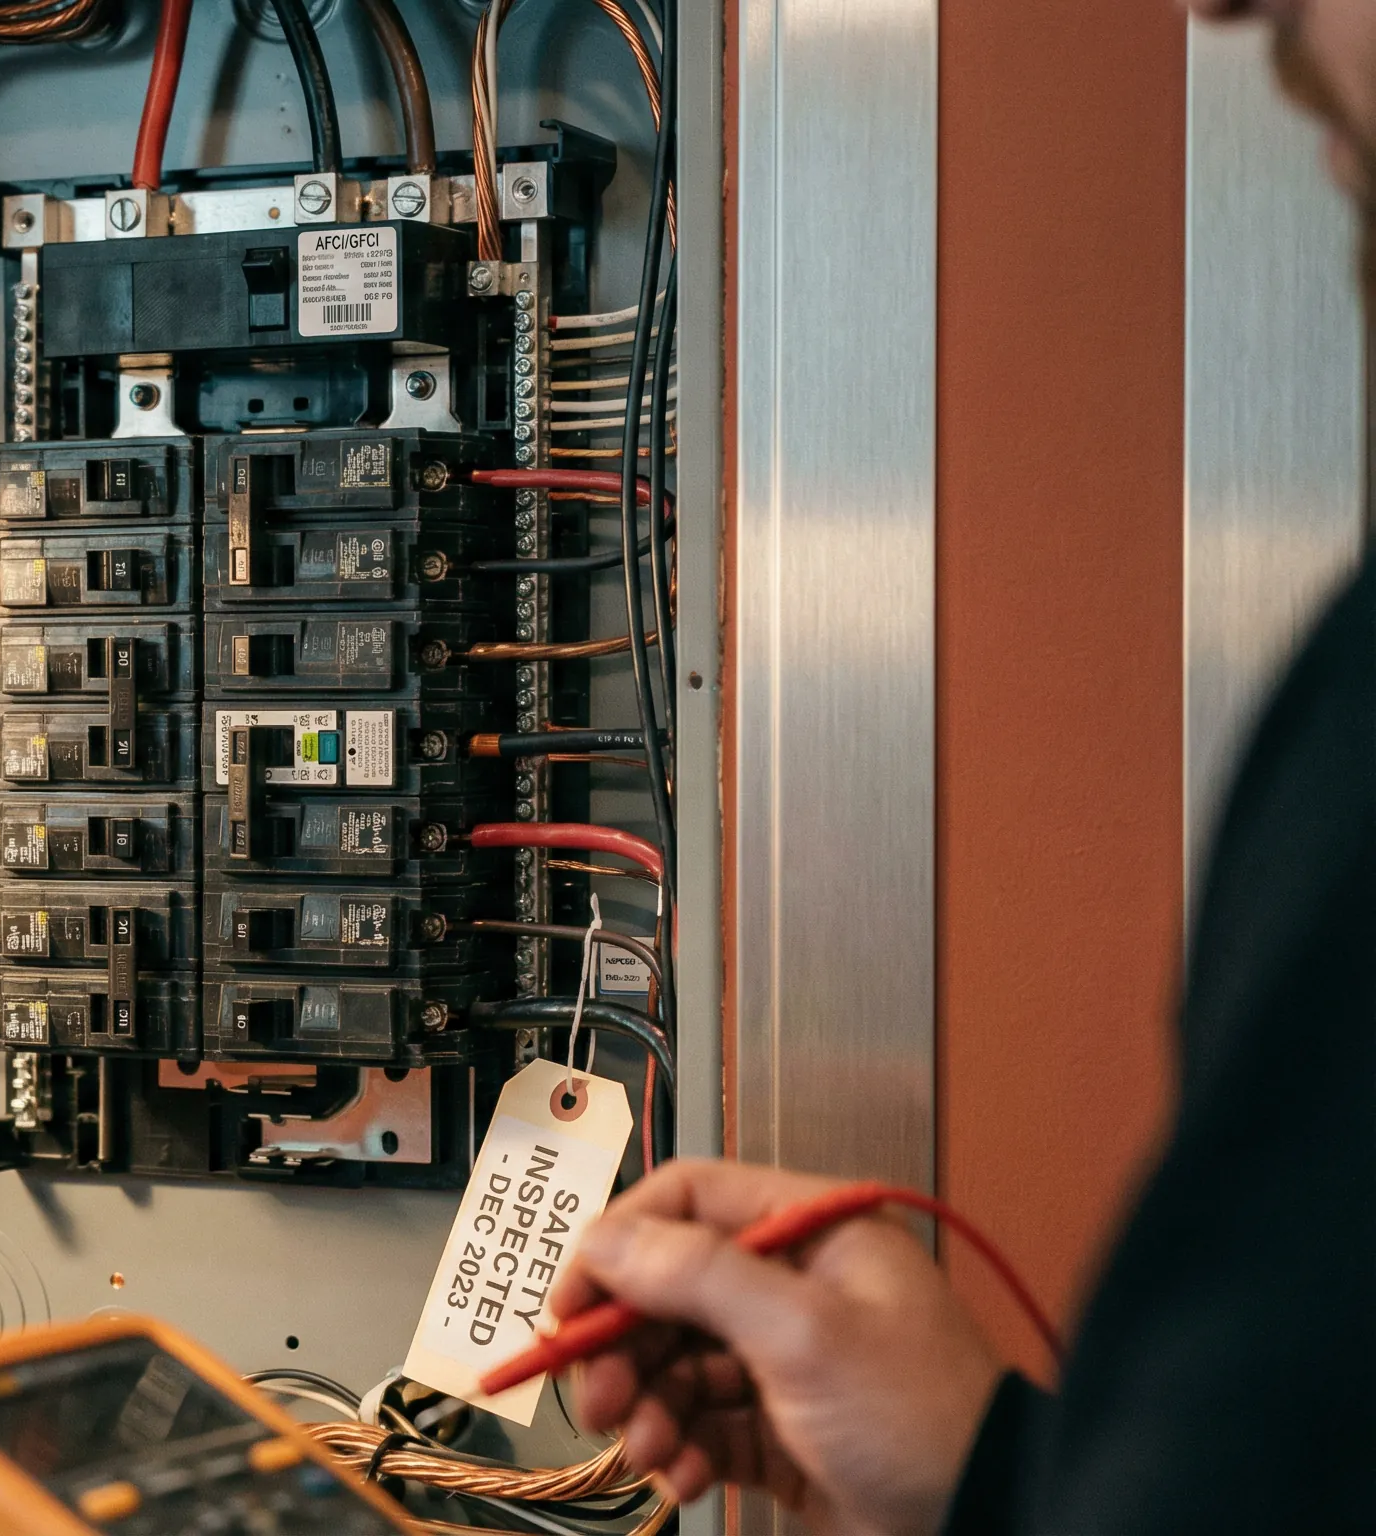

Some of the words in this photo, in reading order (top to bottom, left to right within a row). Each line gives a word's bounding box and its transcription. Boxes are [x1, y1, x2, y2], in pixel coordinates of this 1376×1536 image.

[315, 232, 379, 251] AFCI/GFCI
[473, 1172, 512, 1236] DEC
[447, 1241, 486, 1310] 2023
[469, 1144, 560, 1346] INSPECTED
[513, 1189, 580, 1332] SAFETY
